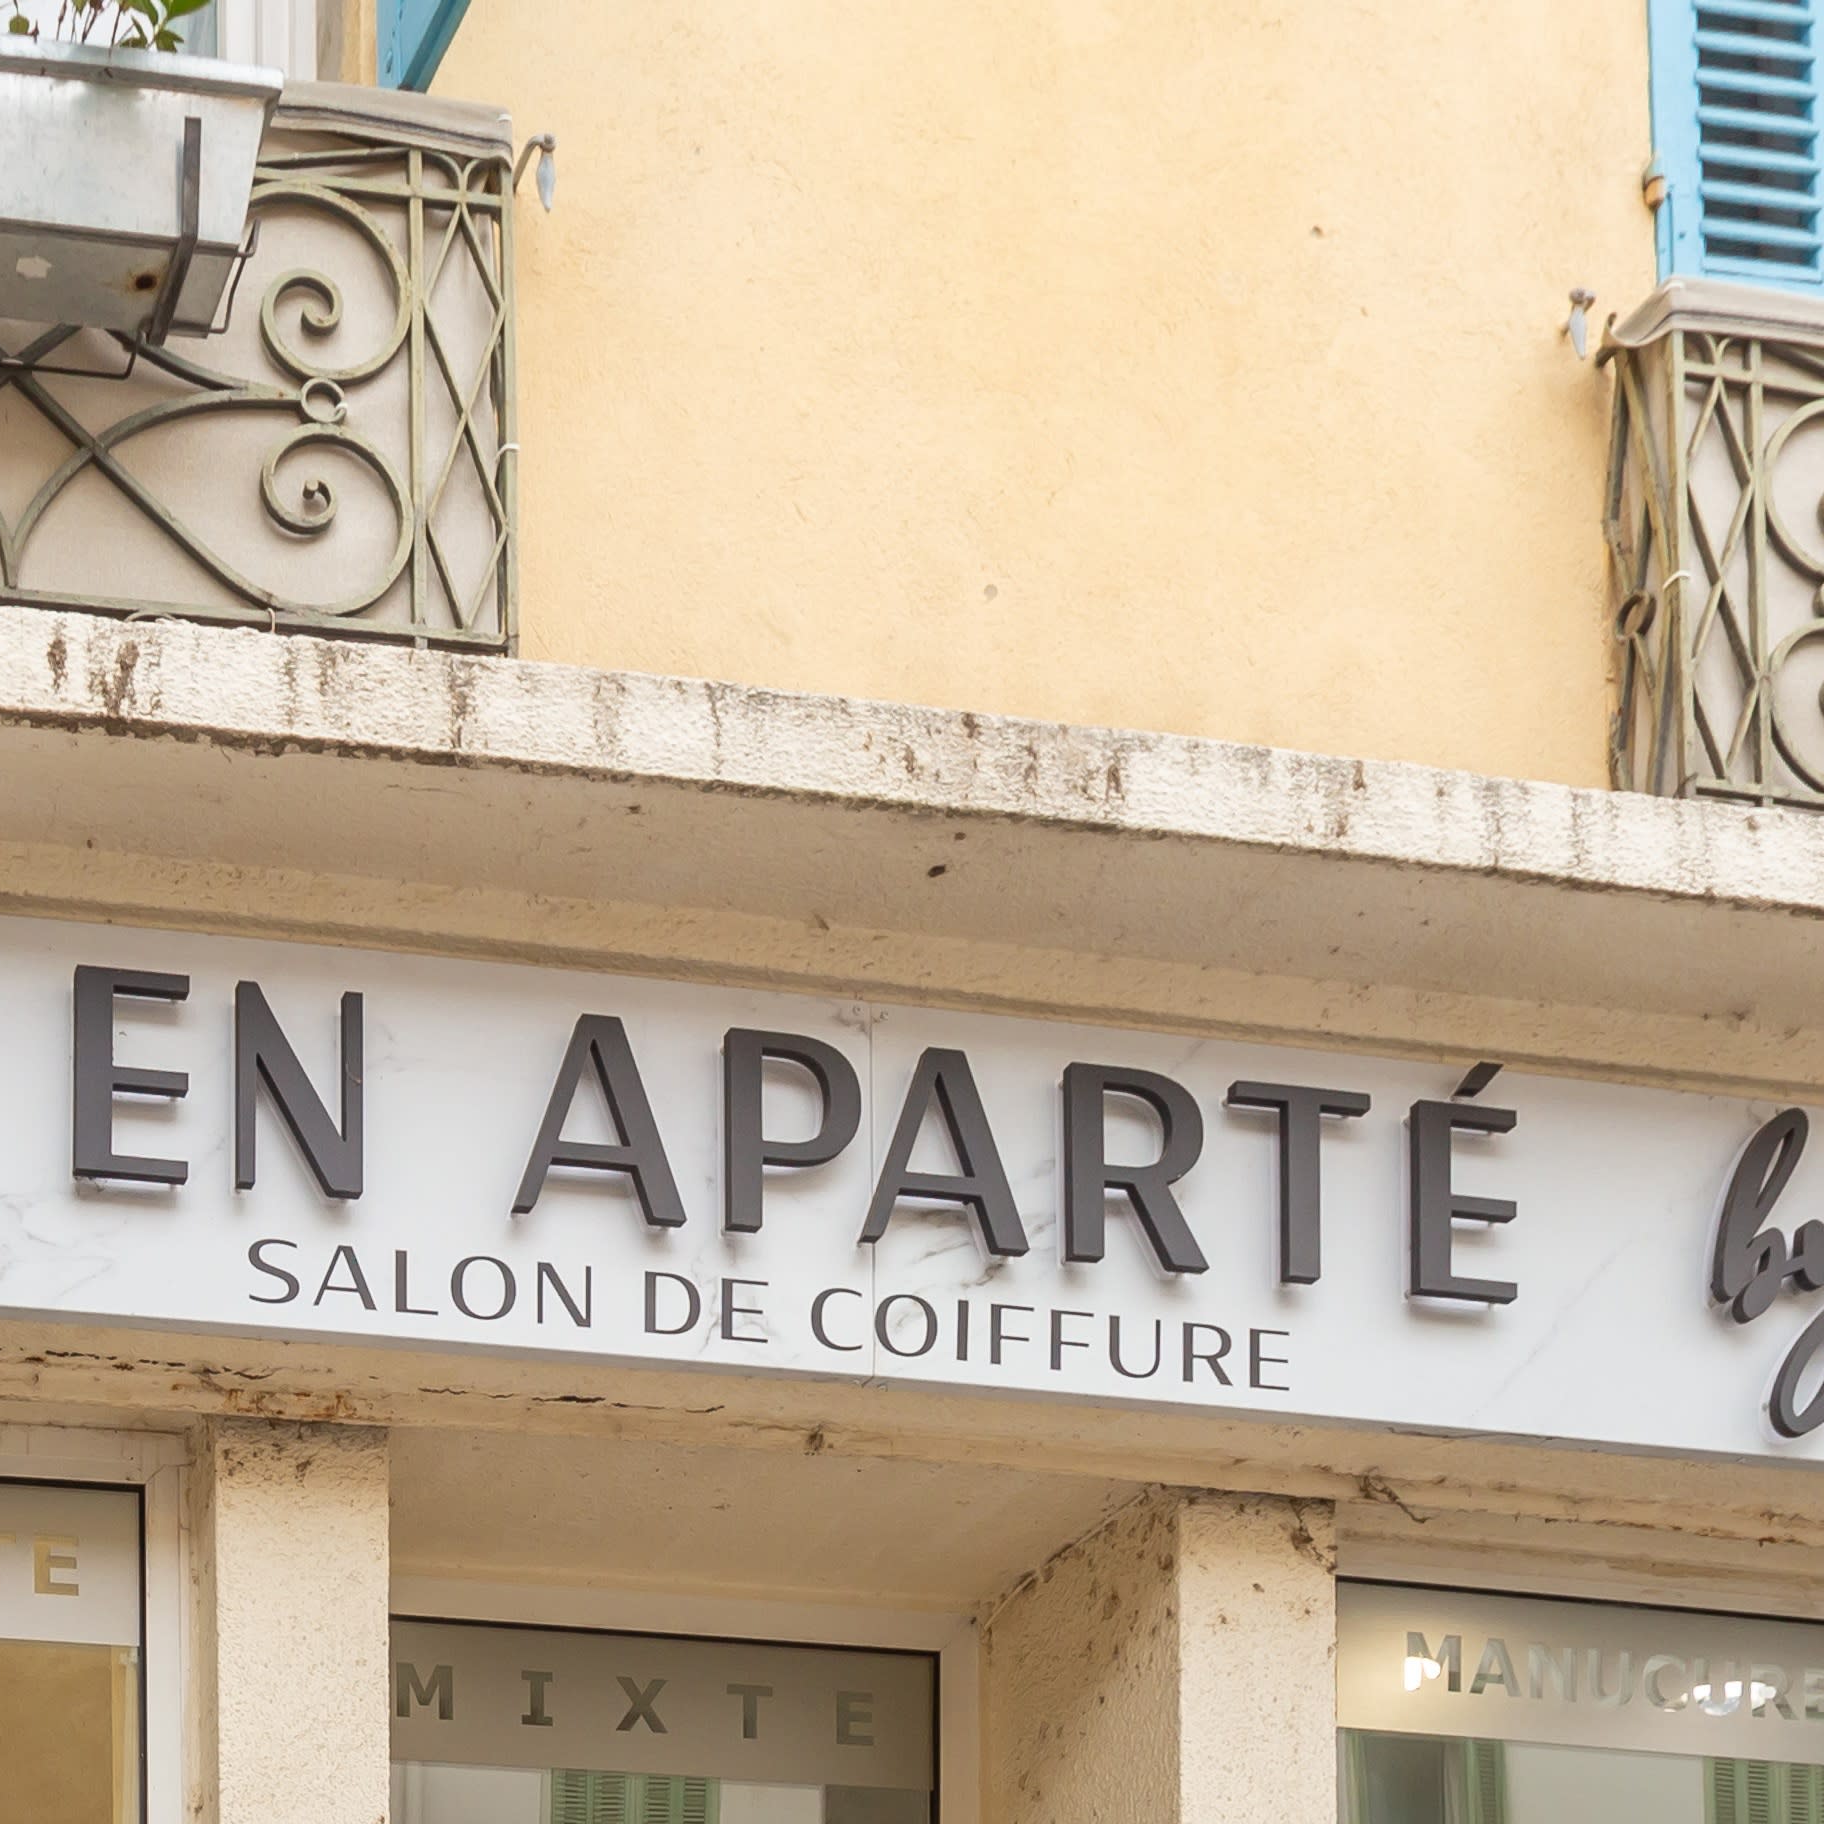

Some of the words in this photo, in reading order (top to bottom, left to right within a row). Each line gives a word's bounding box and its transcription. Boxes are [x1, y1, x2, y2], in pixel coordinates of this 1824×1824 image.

[73, 963, 364, 1200] EN
[511, 1014, 1518, 1305] APARTÉ
[246, 1237, 594, 1329] SALON
[645, 1271, 771, 1345] DE
[811, 1286, 1291, 1391] COIFFURE
[395, 1662, 874, 1746] MIXTE
